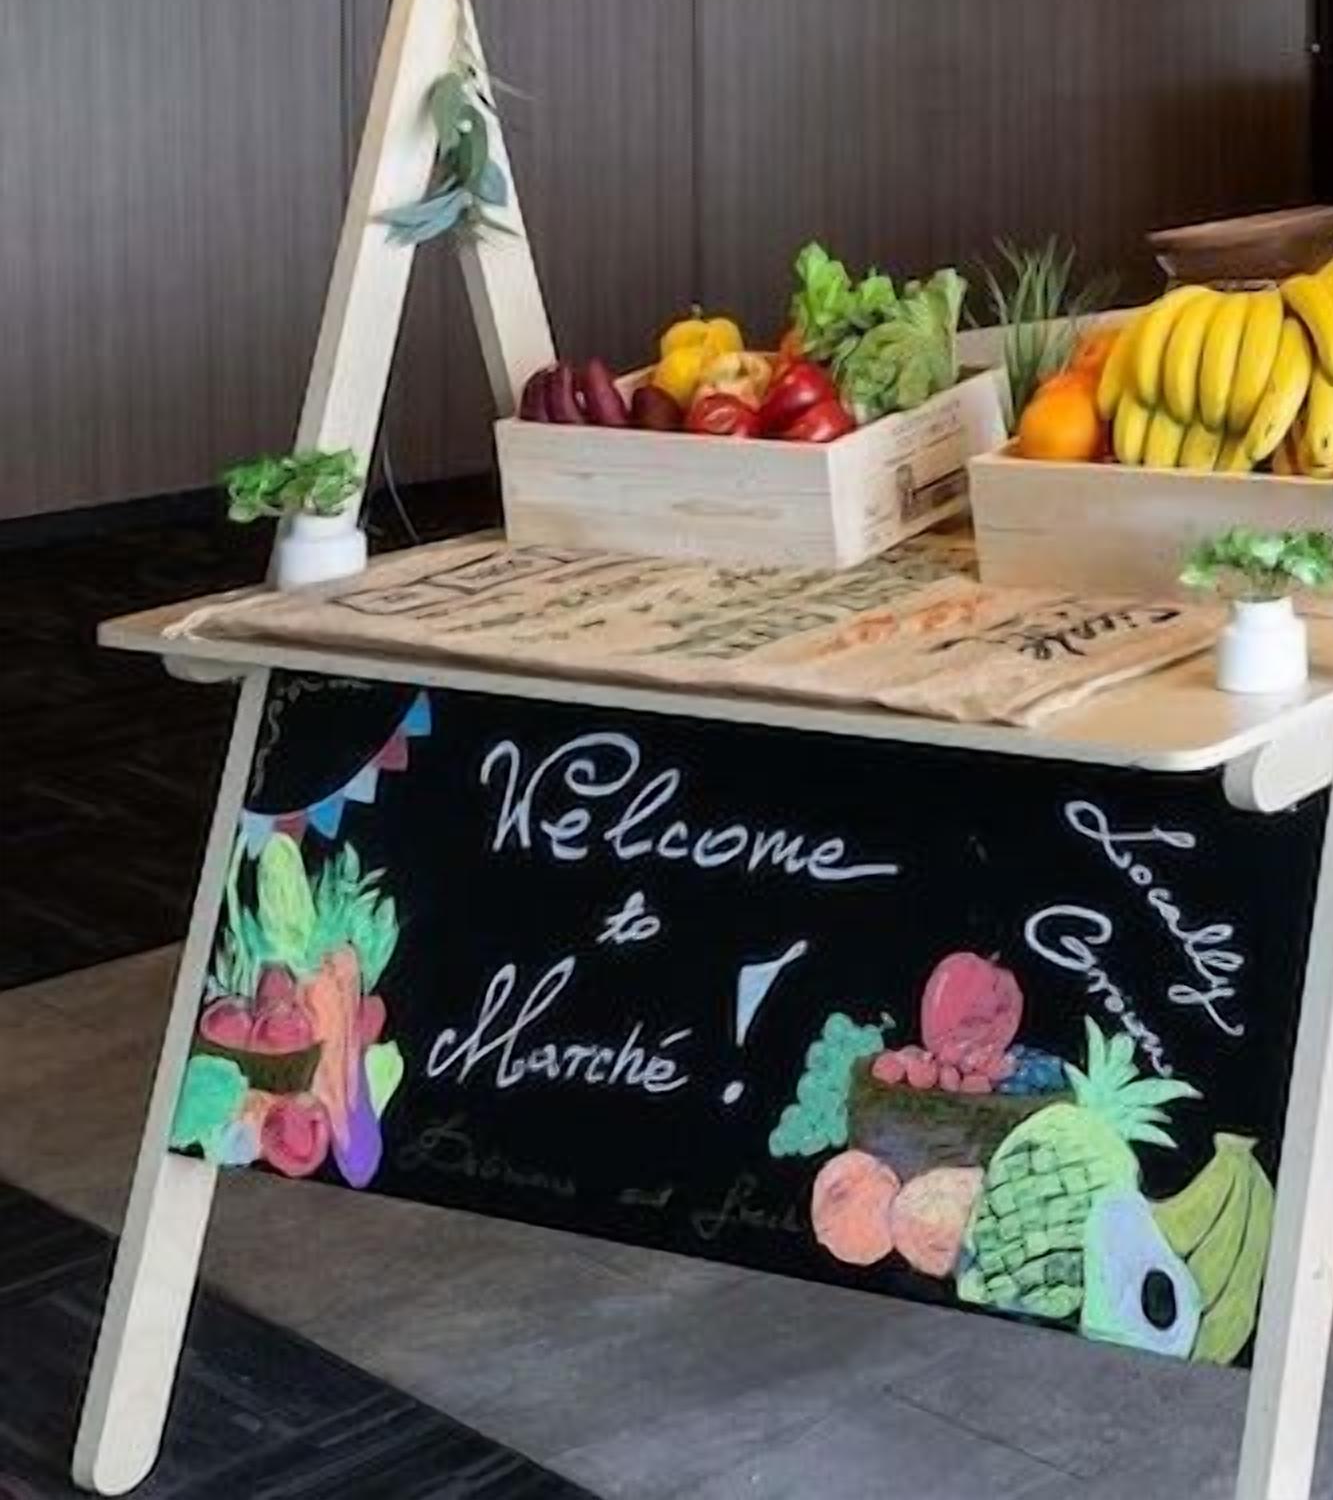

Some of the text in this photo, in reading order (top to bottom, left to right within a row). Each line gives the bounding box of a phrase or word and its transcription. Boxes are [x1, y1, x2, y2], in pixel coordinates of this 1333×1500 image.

[480, 731, 899, 880] Welcome
[597, 890, 661, 945] to
[1064, 799, 1245, 1036] Locally
